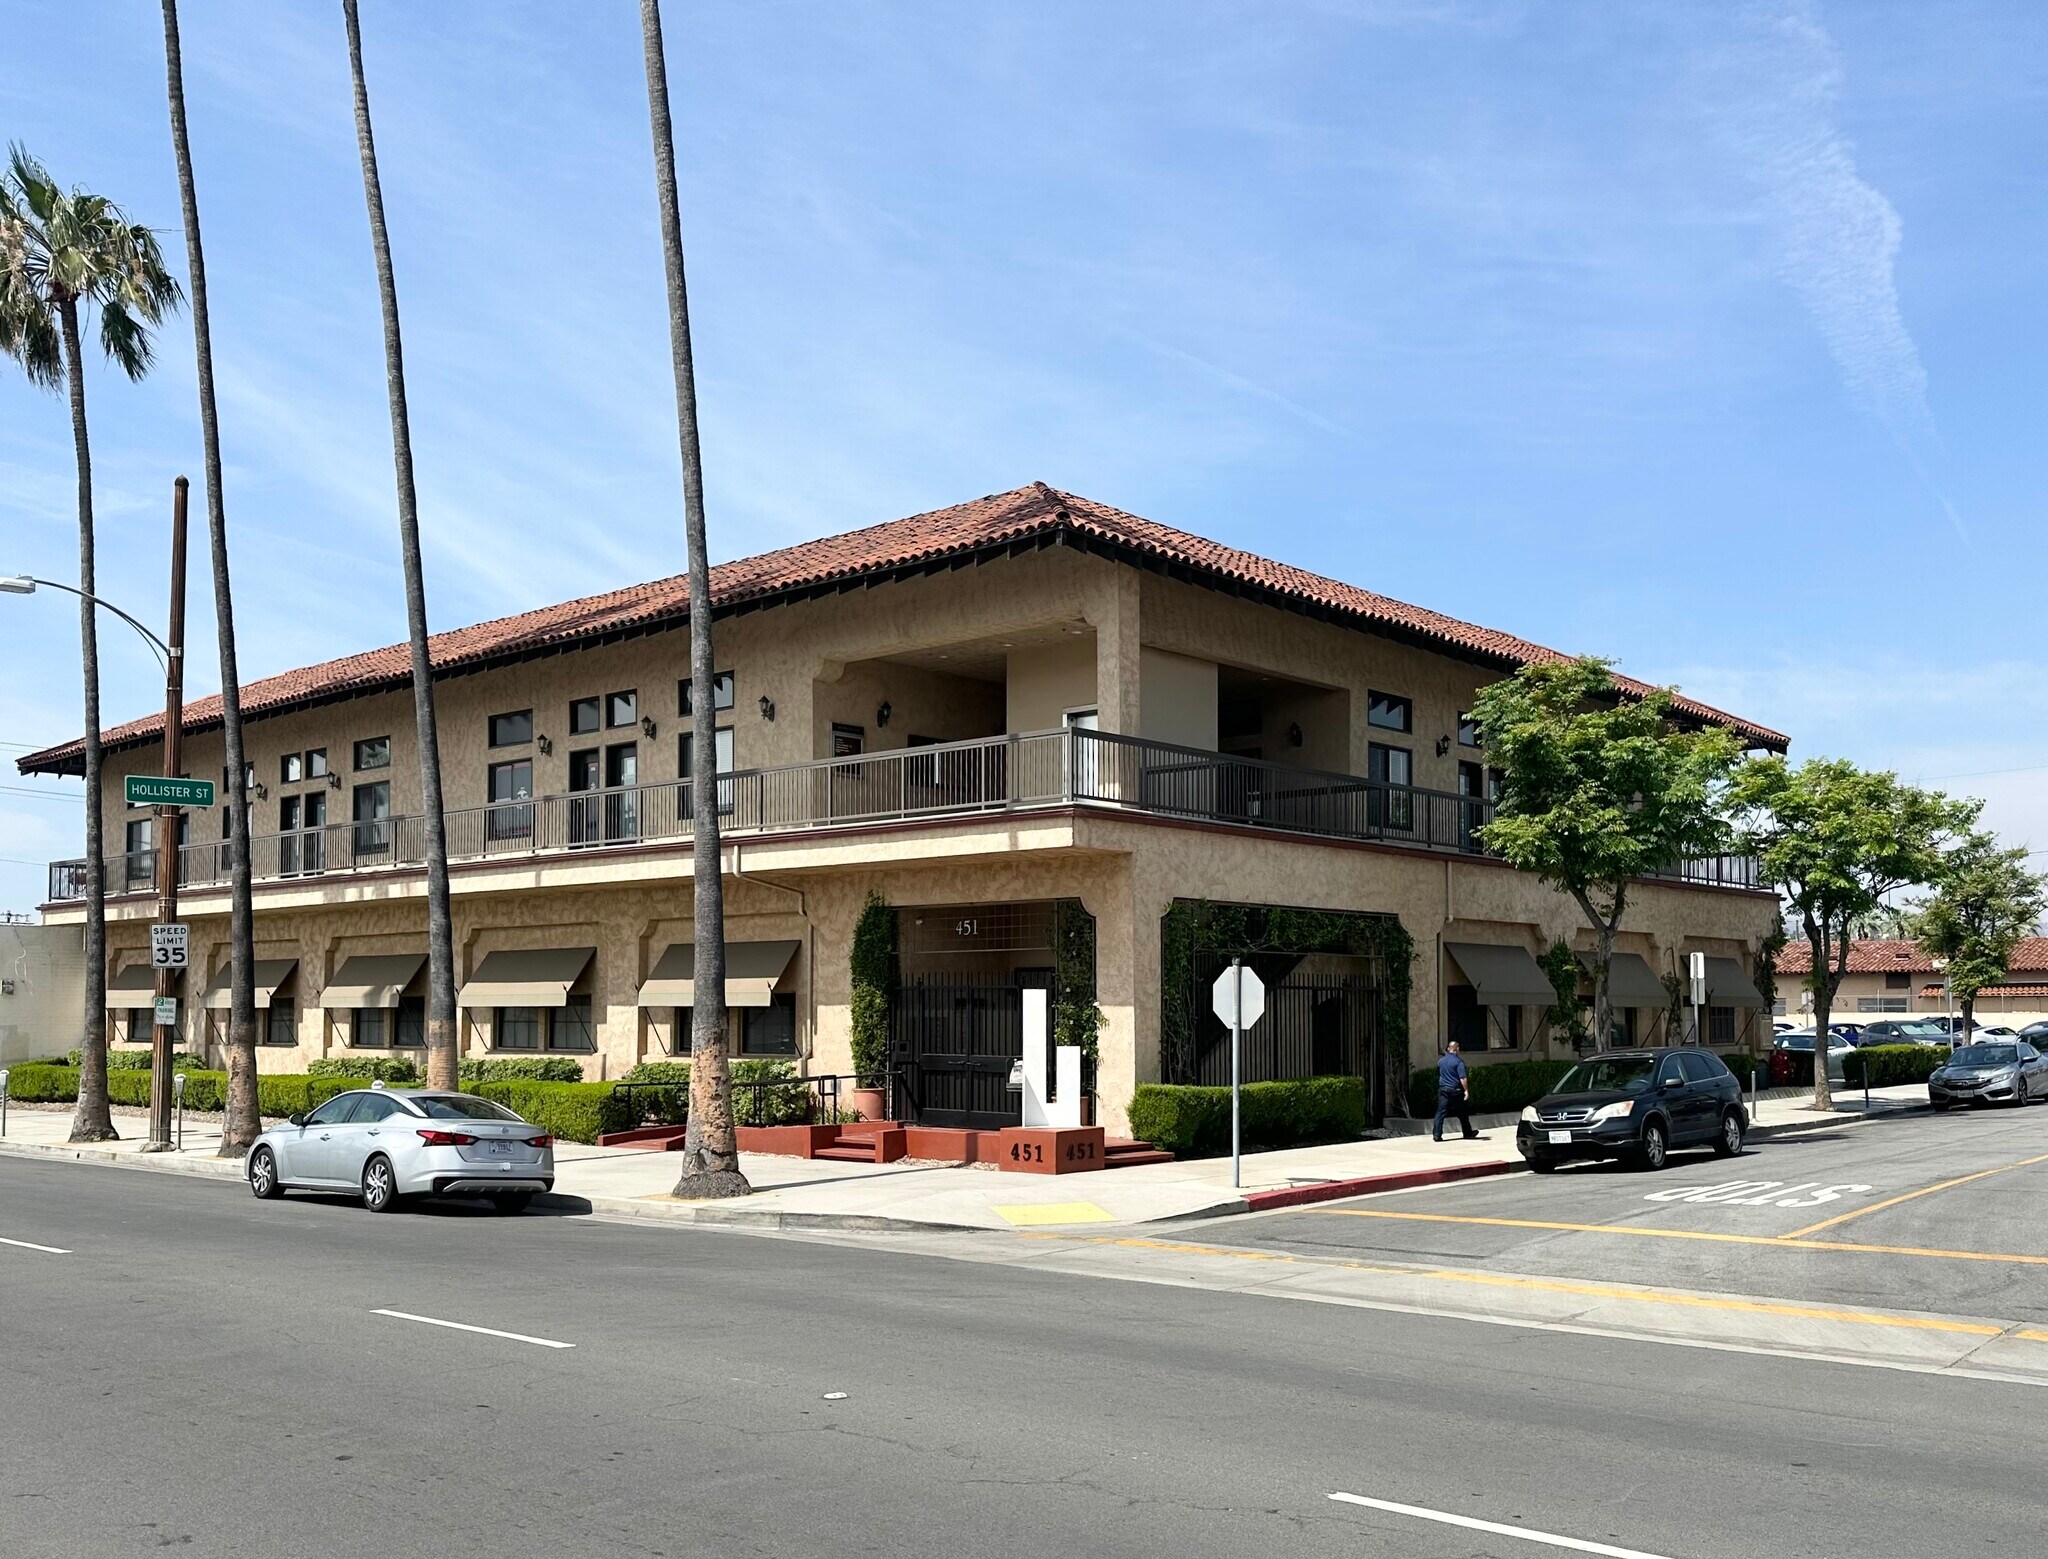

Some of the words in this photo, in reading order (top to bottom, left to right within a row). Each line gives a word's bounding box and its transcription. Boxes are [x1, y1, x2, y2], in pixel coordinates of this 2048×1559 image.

[131, 784, 190, 798] HOLLISTER
[195, 788, 209, 799] ST
[153, 927, 187, 935] SPEED
[955, 919, 979, 936] 451
[156, 937, 184, 945] LIMIT
[155, 947, 186, 964] 35
[1010, 1143, 1043, 1163] 451
[1066, 1142, 1096, 1161] 451
[1643, 1180, 1873, 1208] STOP
